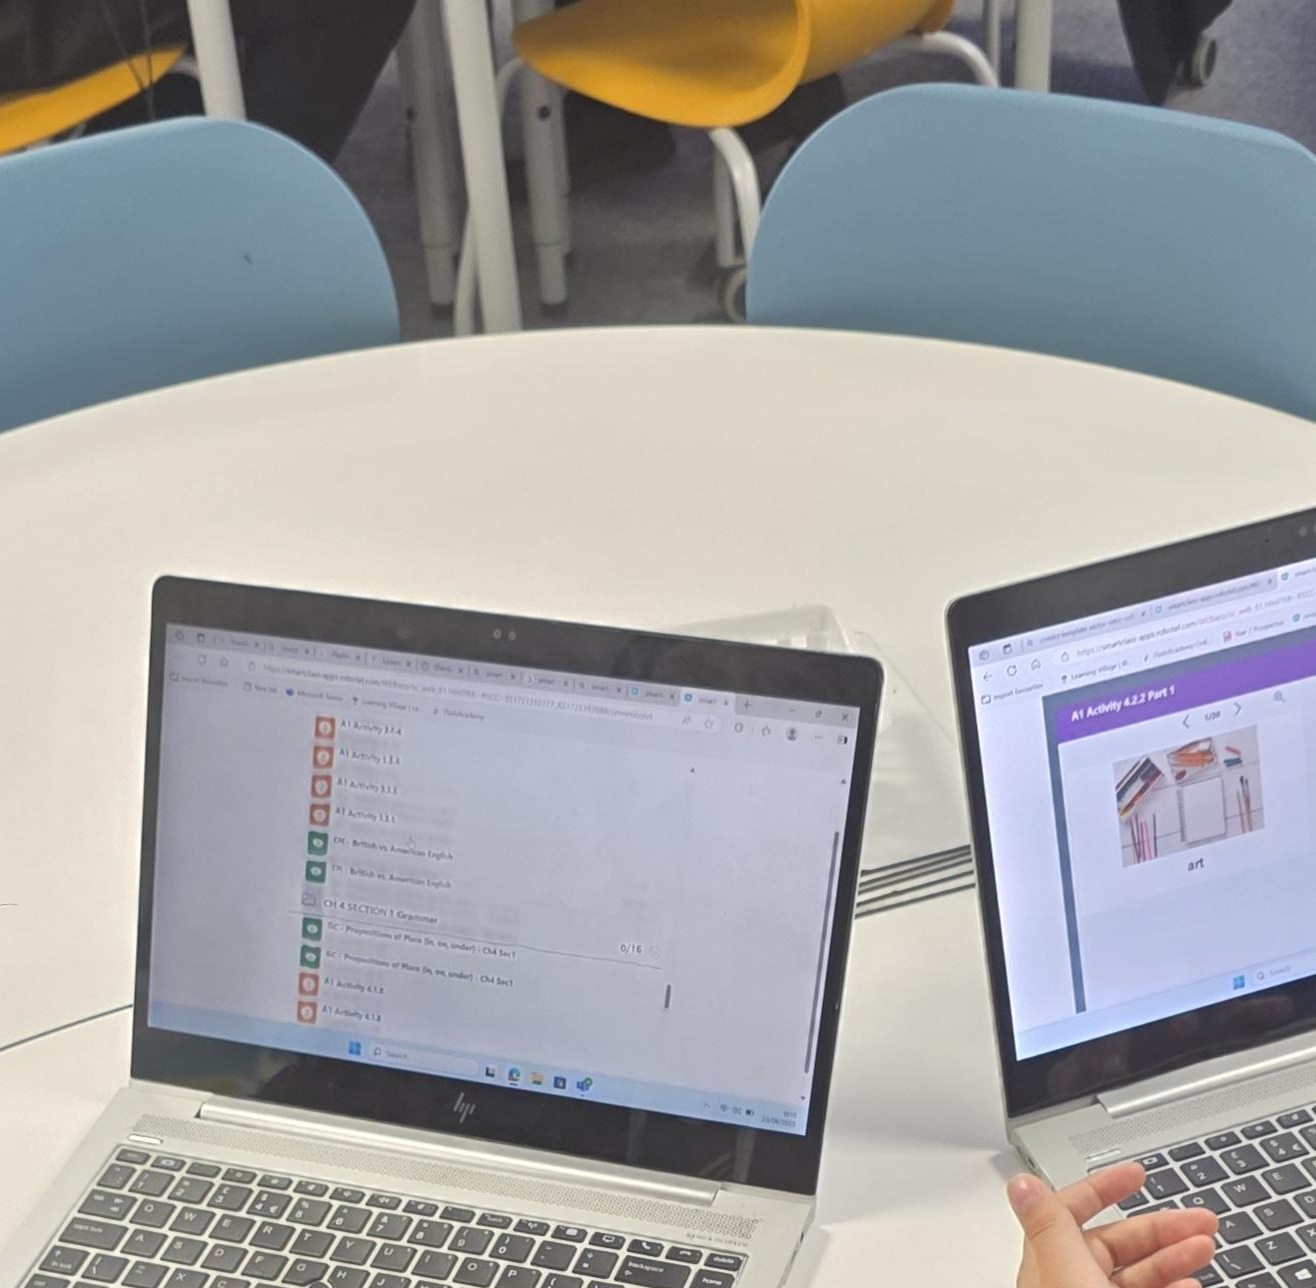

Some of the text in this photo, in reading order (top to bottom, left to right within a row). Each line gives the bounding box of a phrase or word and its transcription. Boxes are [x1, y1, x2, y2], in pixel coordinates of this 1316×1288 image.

[1070, 708, 1084, 722] A1
[1085, 698, 1122, 720] Activity
[1122, 692, 1146, 708] 4.2.2
[1147, 686, 1168, 702] Part
[353, 720, 383, 735] Activity
[351, 750, 381, 765] Activity
[348, 779, 379, 793] Activity
[347, 808, 377, 823] Activity
[1186, 856, 1205, 872] art
[345, 902, 388, 917] SECTION
[395, 909, 439, 925] Grammar
[619, 941, 643, 956] 0/16
[336, 979, 365, 993] Activity
[334, 1006, 363, 1021] Activity
